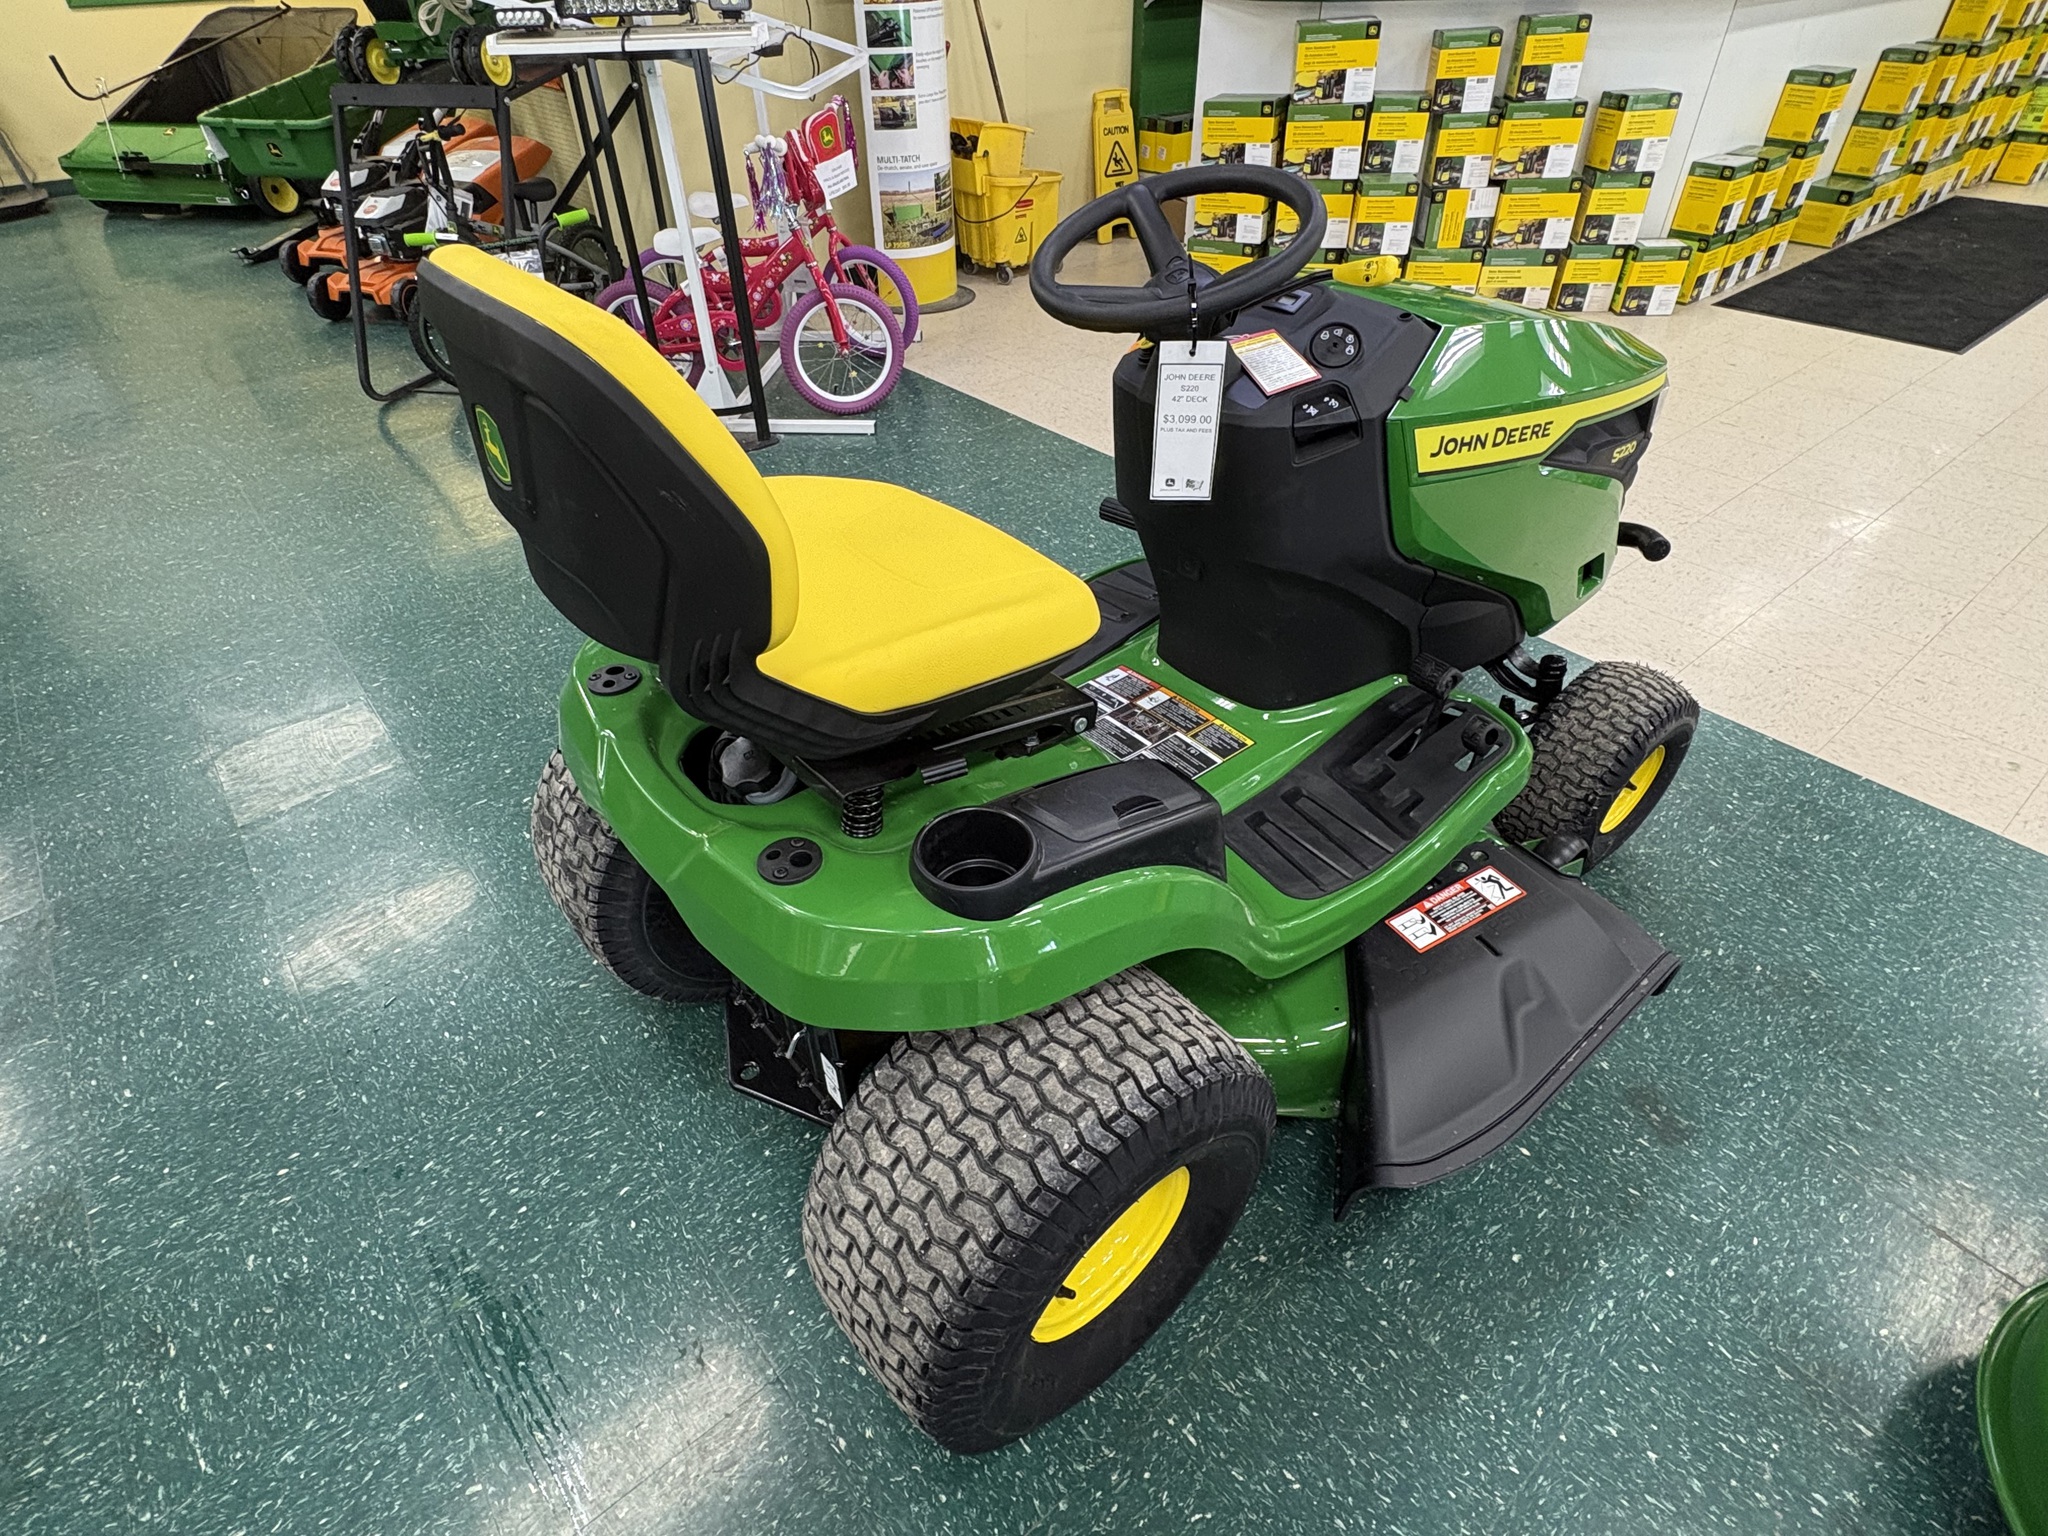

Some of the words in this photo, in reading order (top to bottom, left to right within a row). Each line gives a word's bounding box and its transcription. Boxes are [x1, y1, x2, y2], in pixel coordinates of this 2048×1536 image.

[1103, 125, 1129, 136] CAUTION
[876, 154, 921, 164] MULTI-TATCH
[1171, 395, 1184, 403] 42"
[1163, 414, 1212, 425] $3,099.00
[1429, 432, 1490, 458] JOHN
[1491, 420, 1554, 449] DEERE
[1611, 440, 1637, 464] S220
[1429, 883, 1466, 905] DANGER
